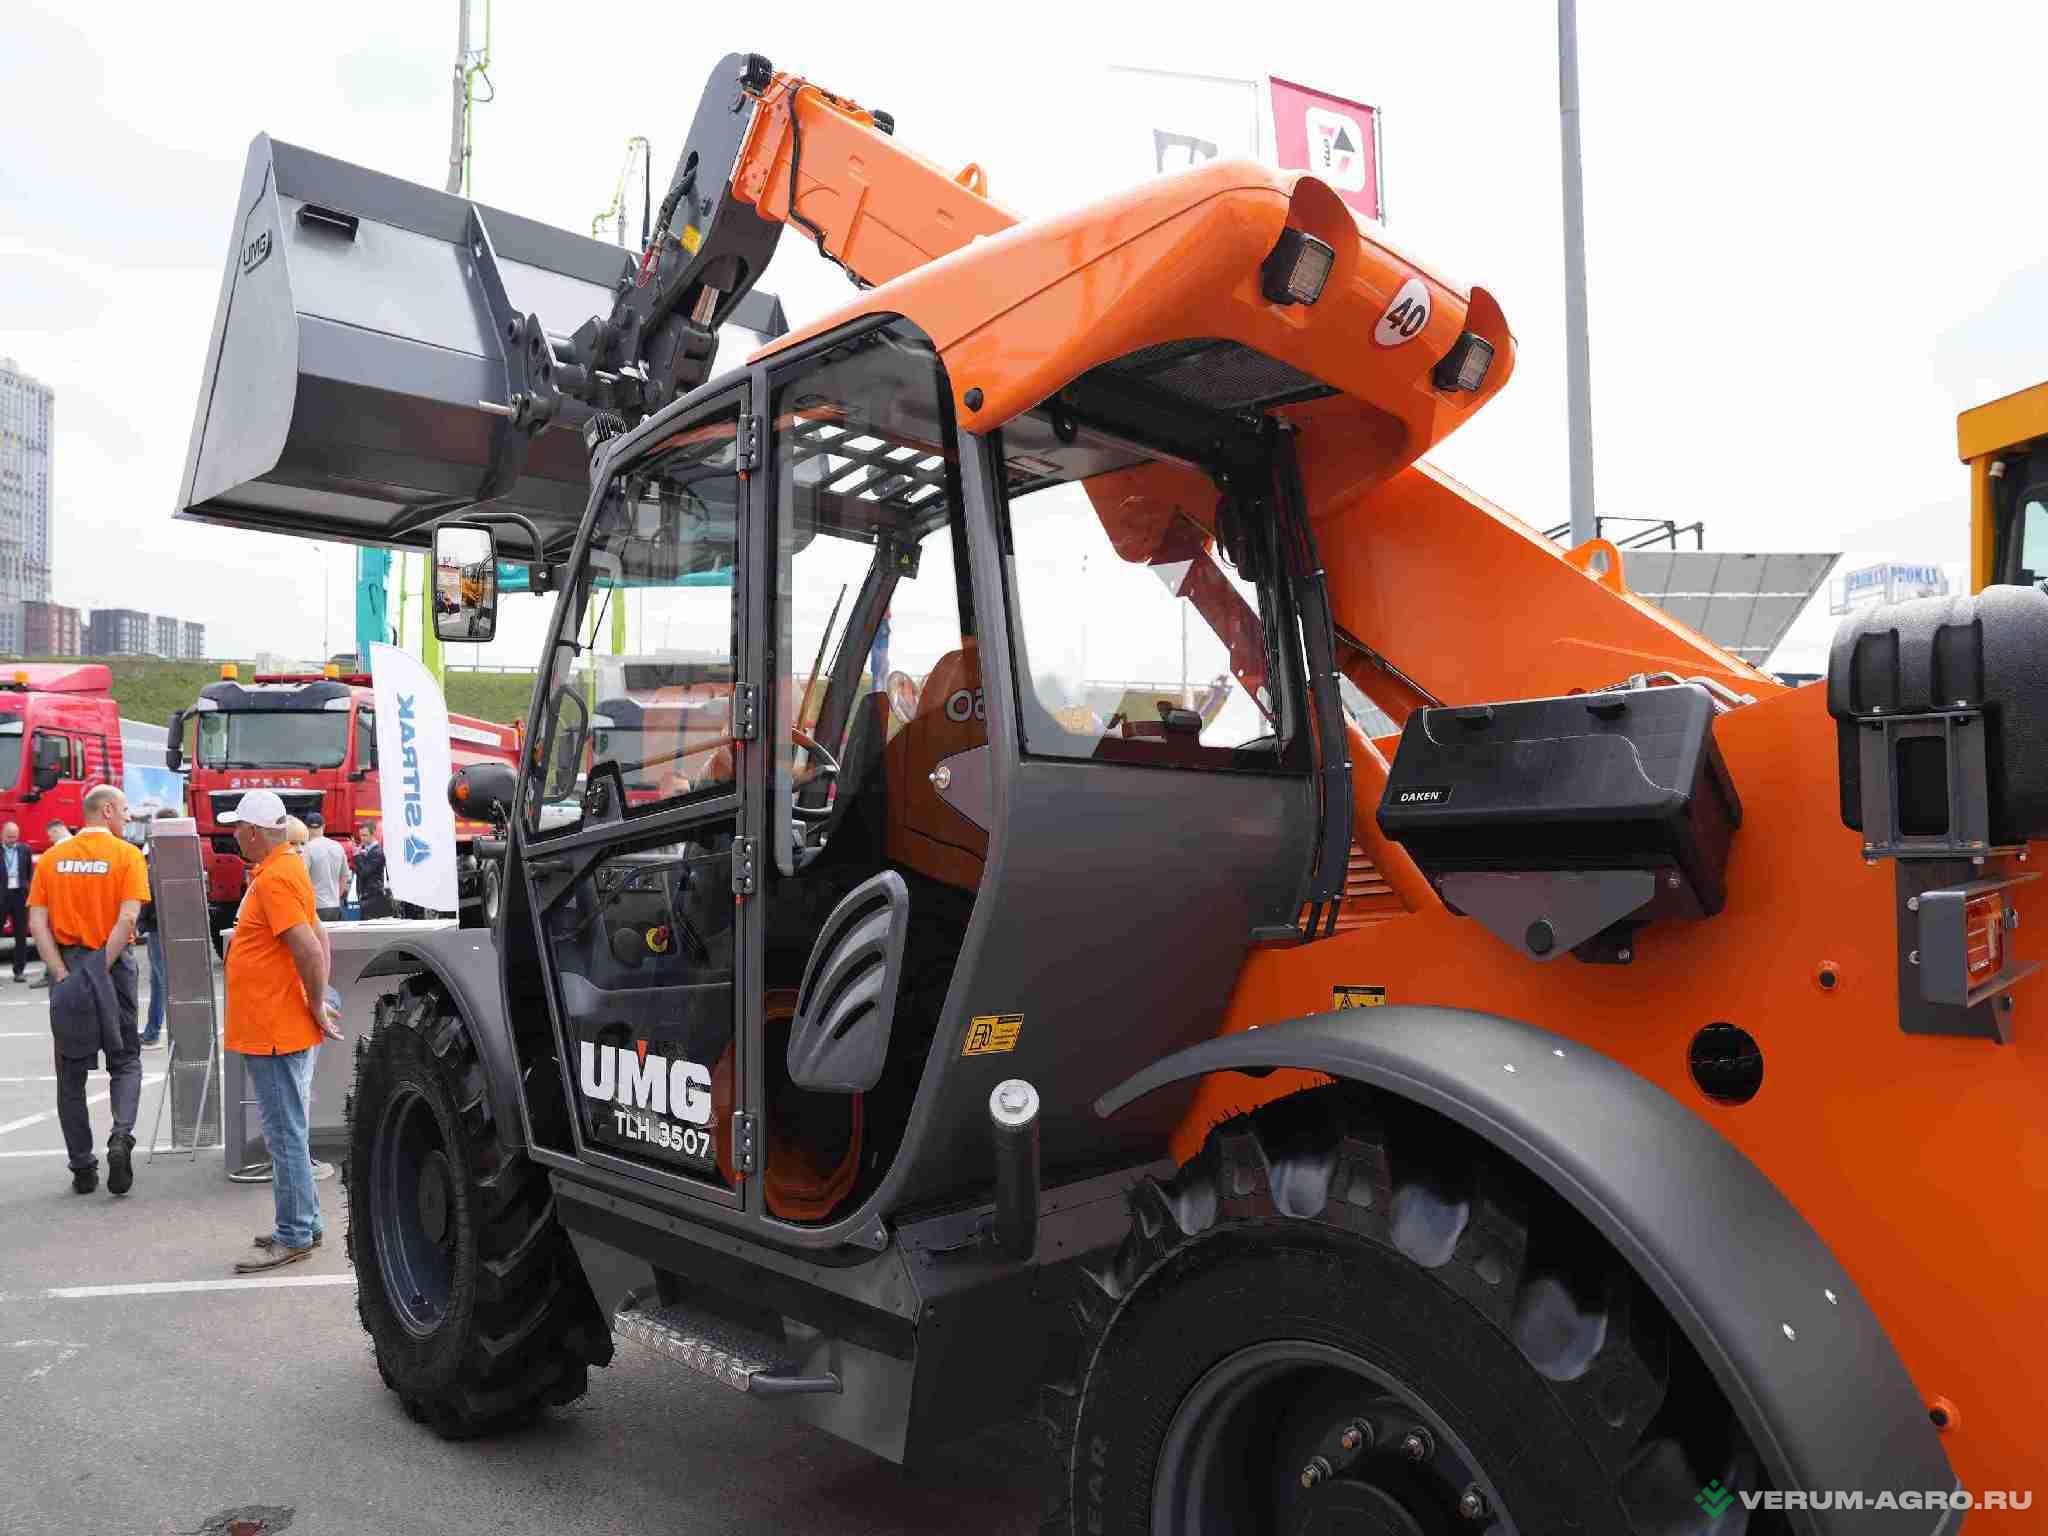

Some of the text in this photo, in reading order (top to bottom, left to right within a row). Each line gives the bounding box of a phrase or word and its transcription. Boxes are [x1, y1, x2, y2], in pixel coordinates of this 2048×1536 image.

[243, 232, 266, 267] UMG
[1387, 297, 1426, 337] 40
[230, 777, 304, 789] SITRAK
[1400, 791, 1440, 802] DAKEN
[56, 860, 110, 875] UMG
[580, 1040, 712, 1125] UMG
[614, 1110, 711, 1158] TLH 3507
